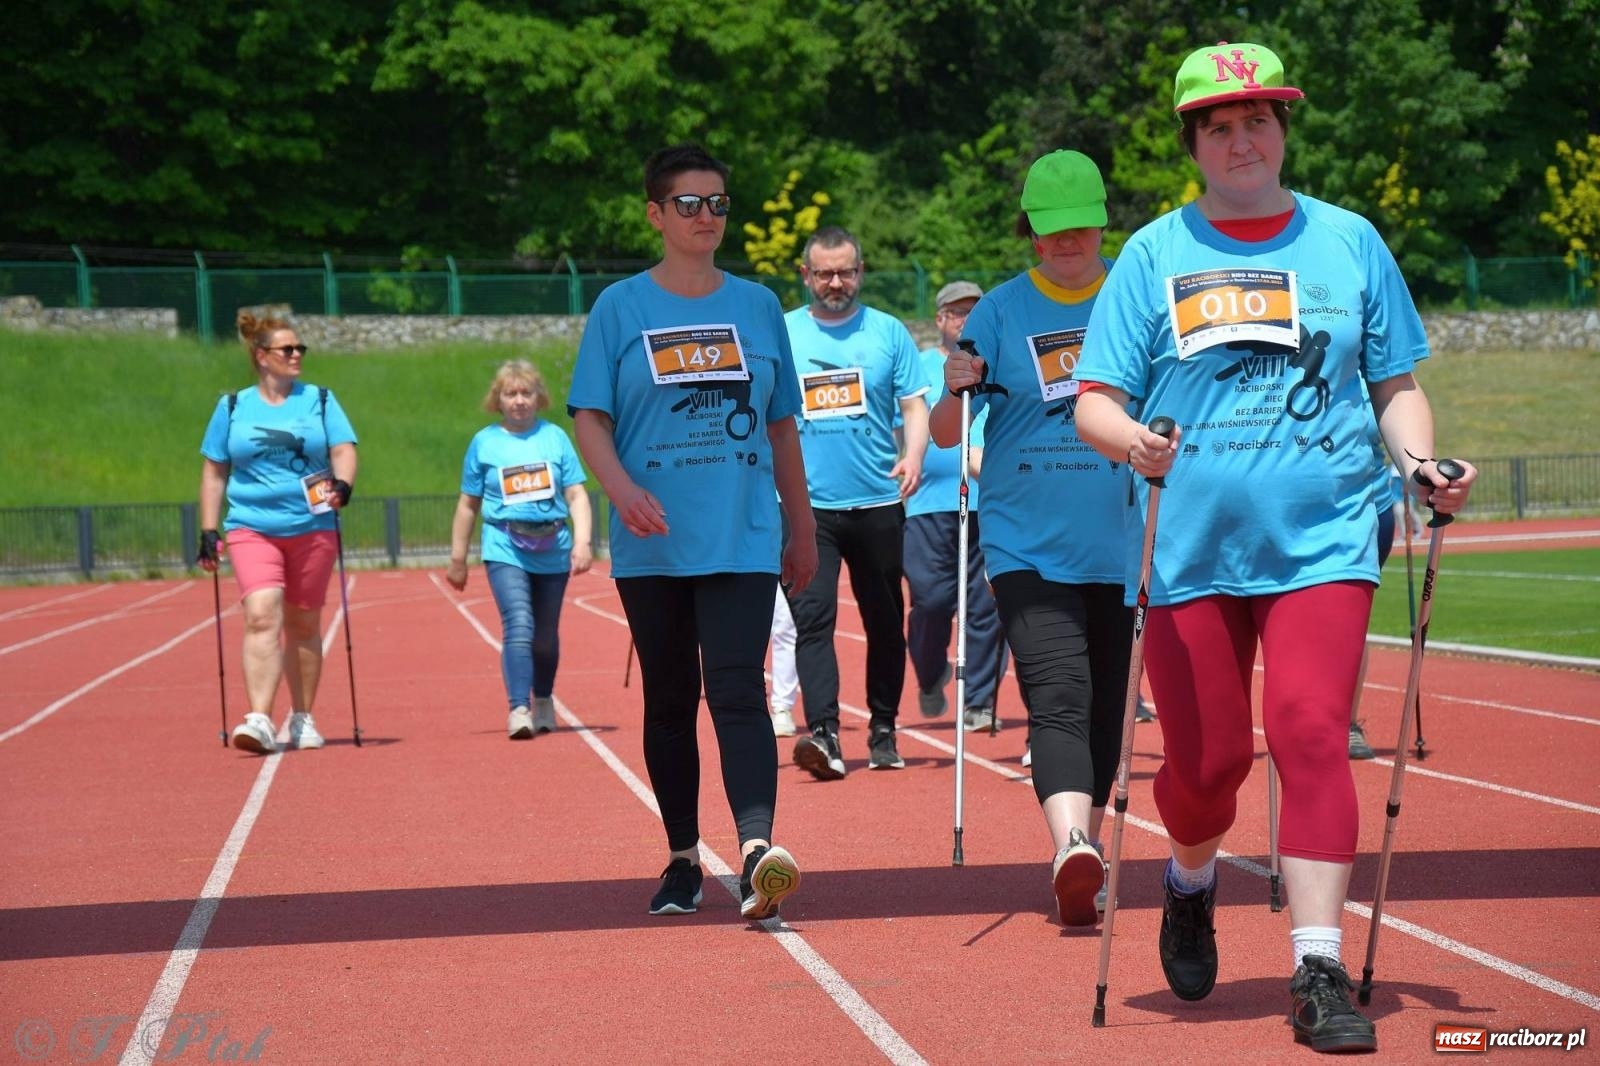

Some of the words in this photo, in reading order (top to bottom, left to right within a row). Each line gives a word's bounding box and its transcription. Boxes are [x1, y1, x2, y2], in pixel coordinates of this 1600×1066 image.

[1200, 291, 1267, 320] 010
[1298, 305, 1350, 317] Racibórz
[674, 345, 721, 368] 149
[1240, 354, 1288, 381] VIII
[1234, 383, 1284, 393] RACIBORSKI
[688, 390, 723, 410] VIII
[815, 386, 850, 407] 003
[1264, 395, 1283, 403] BIEG
[1235, 408, 1250, 416] BEZ
[1252, 406, 1282, 415] BARIER
[1217, 418, 1282, 429] WIŚNIEWSKIEGO
[1228, 440, 1281, 451] Racibórz
[685, 455, 726, 466] Racibórz
[1055, 462, 1099, 471] Racibórz
[511, 473, 542, 491] 044
